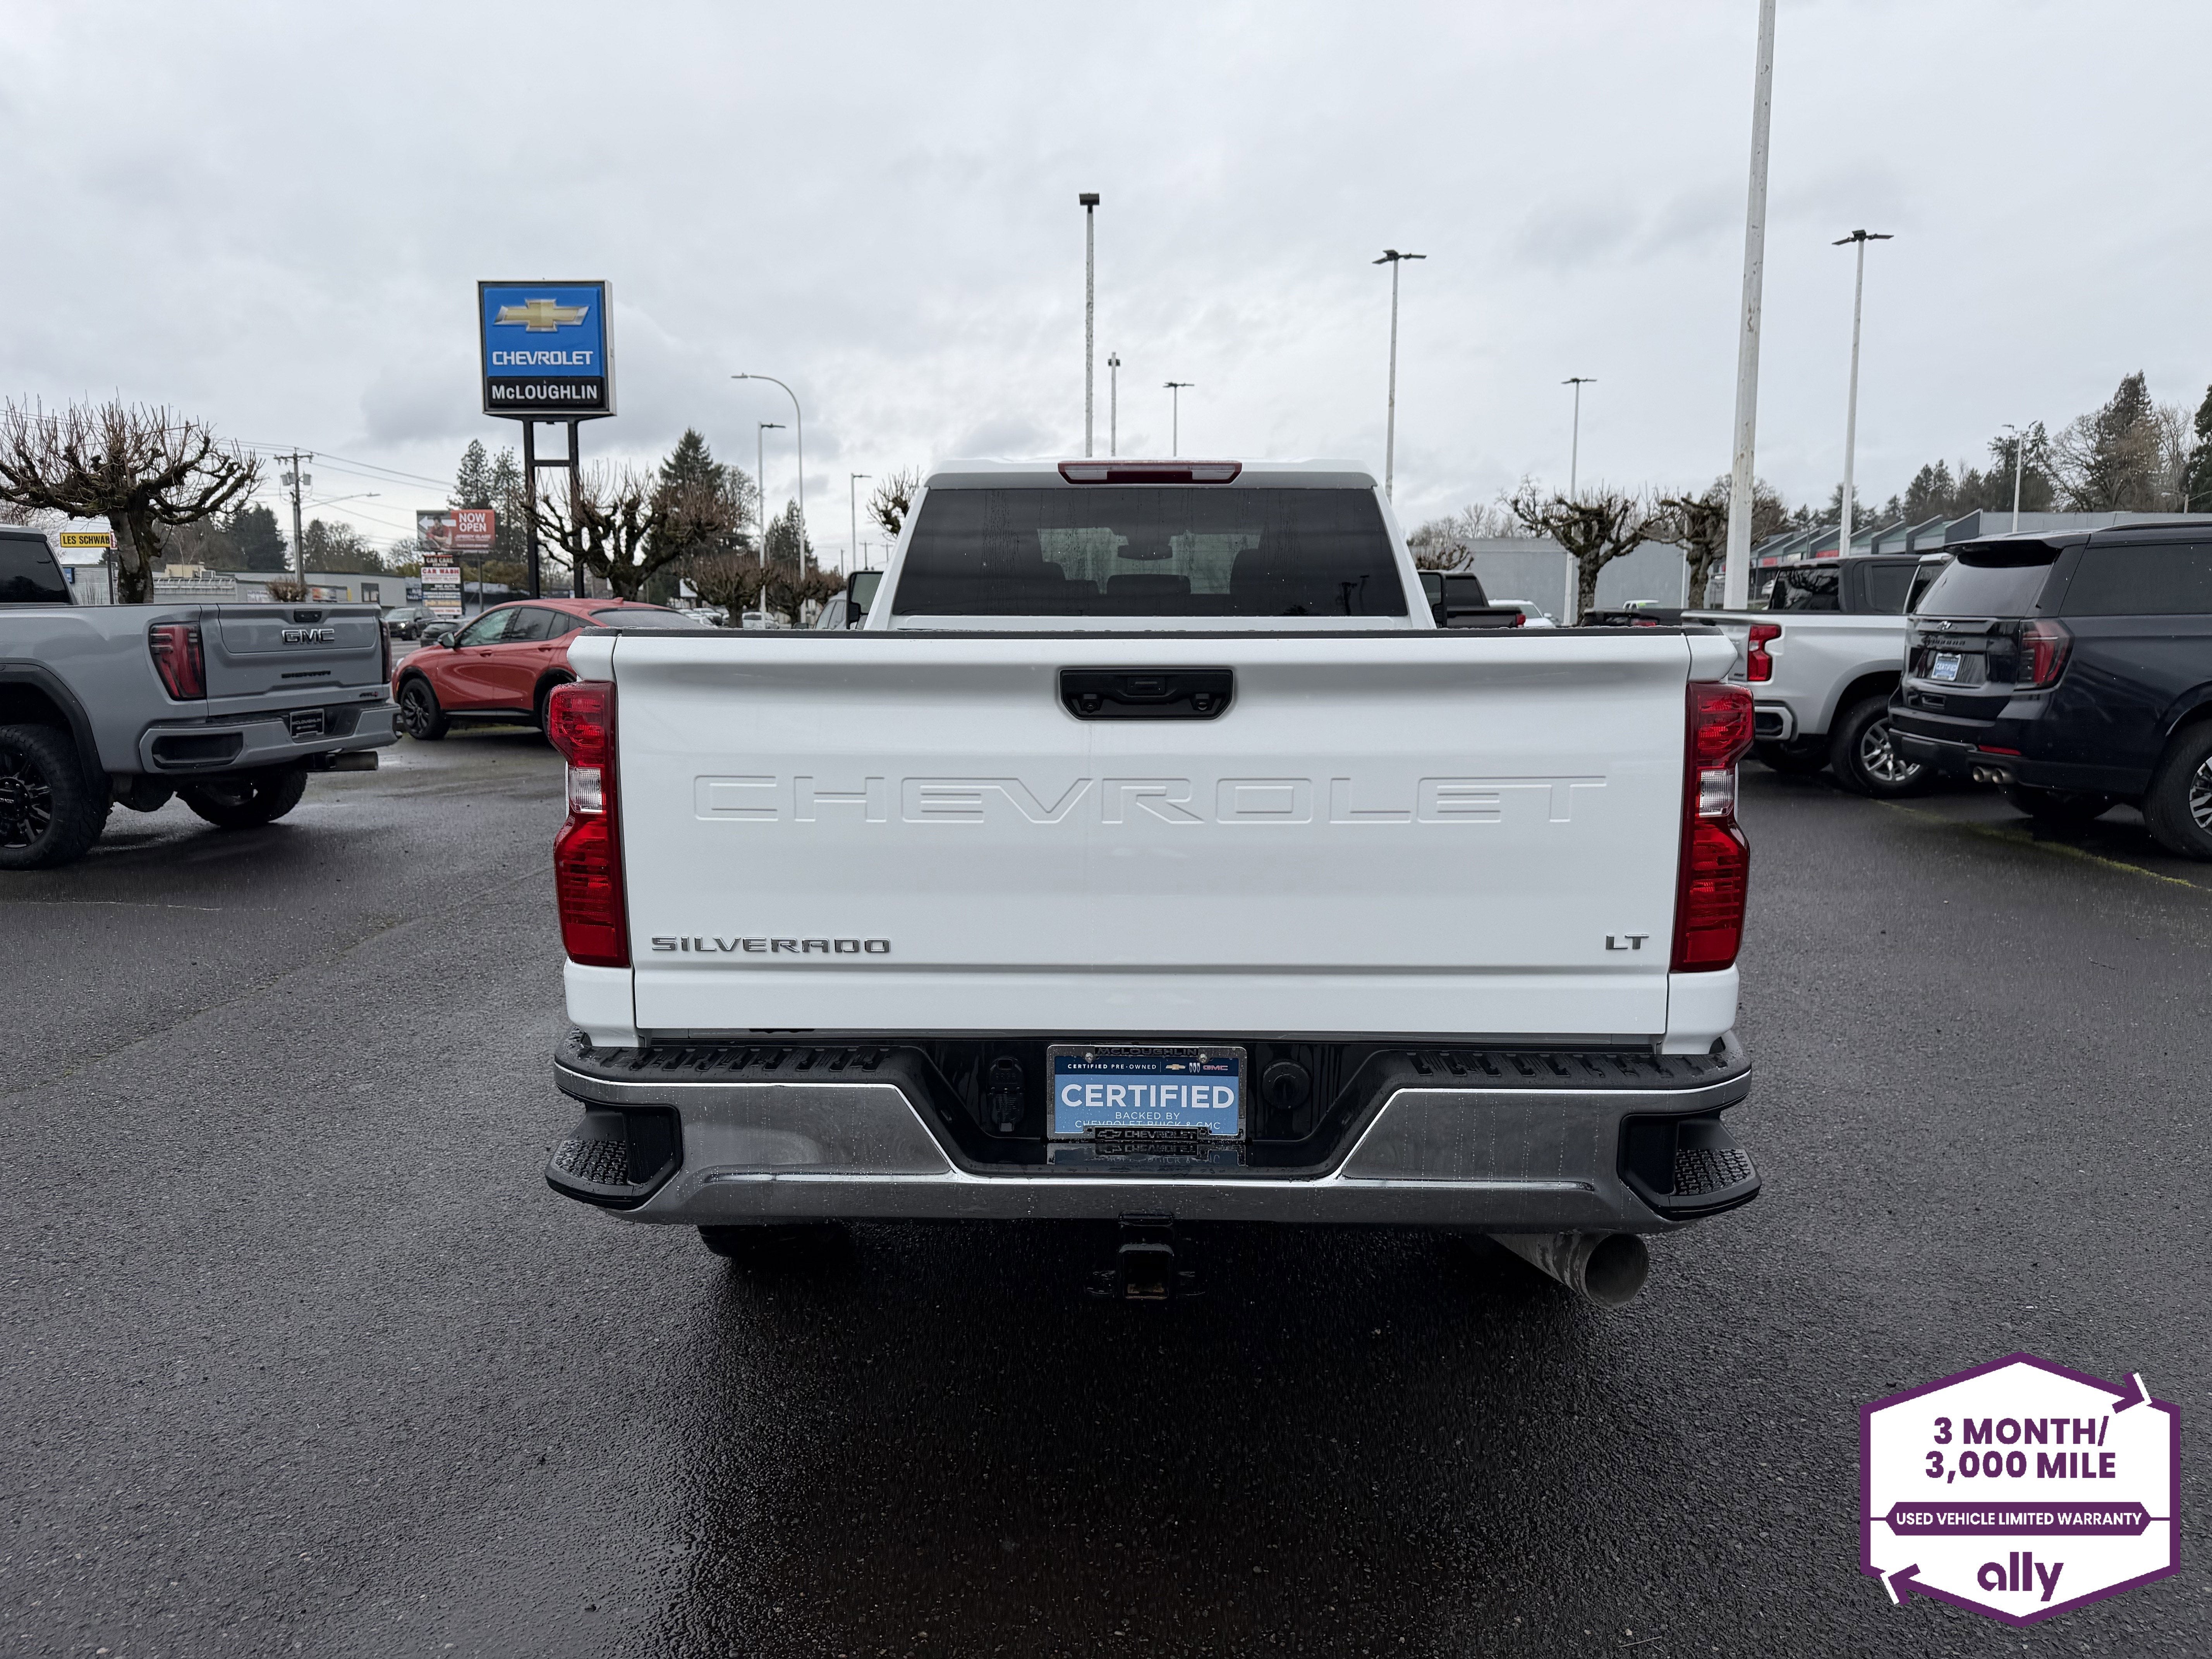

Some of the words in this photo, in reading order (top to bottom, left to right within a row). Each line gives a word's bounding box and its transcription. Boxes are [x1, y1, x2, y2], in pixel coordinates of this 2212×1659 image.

[492, 351, 593, 365] CHEVROLET
[491, 385, 597, 399] McLOUGHLIN
[459, 512, 486, 523] NOW
[459, 523, 487, 532] OPEN
[63, 536, 76, 544] LES
[79, 536, 110, 544] SCHWAB
[282, 628, 335, 644] GMC
[695, 775, 1607, 824] CHEVROLET
[651, 935, 891, 953] SILVERADO
[1606, 934, 1649, 950] LT
[1097, 1047, 1197, 1056] MCLOUGHLIN
[1061, 1084, 1235, 1109] CERTIFIED
[1125, 1130, 1197, 1139] CHEVROLET
